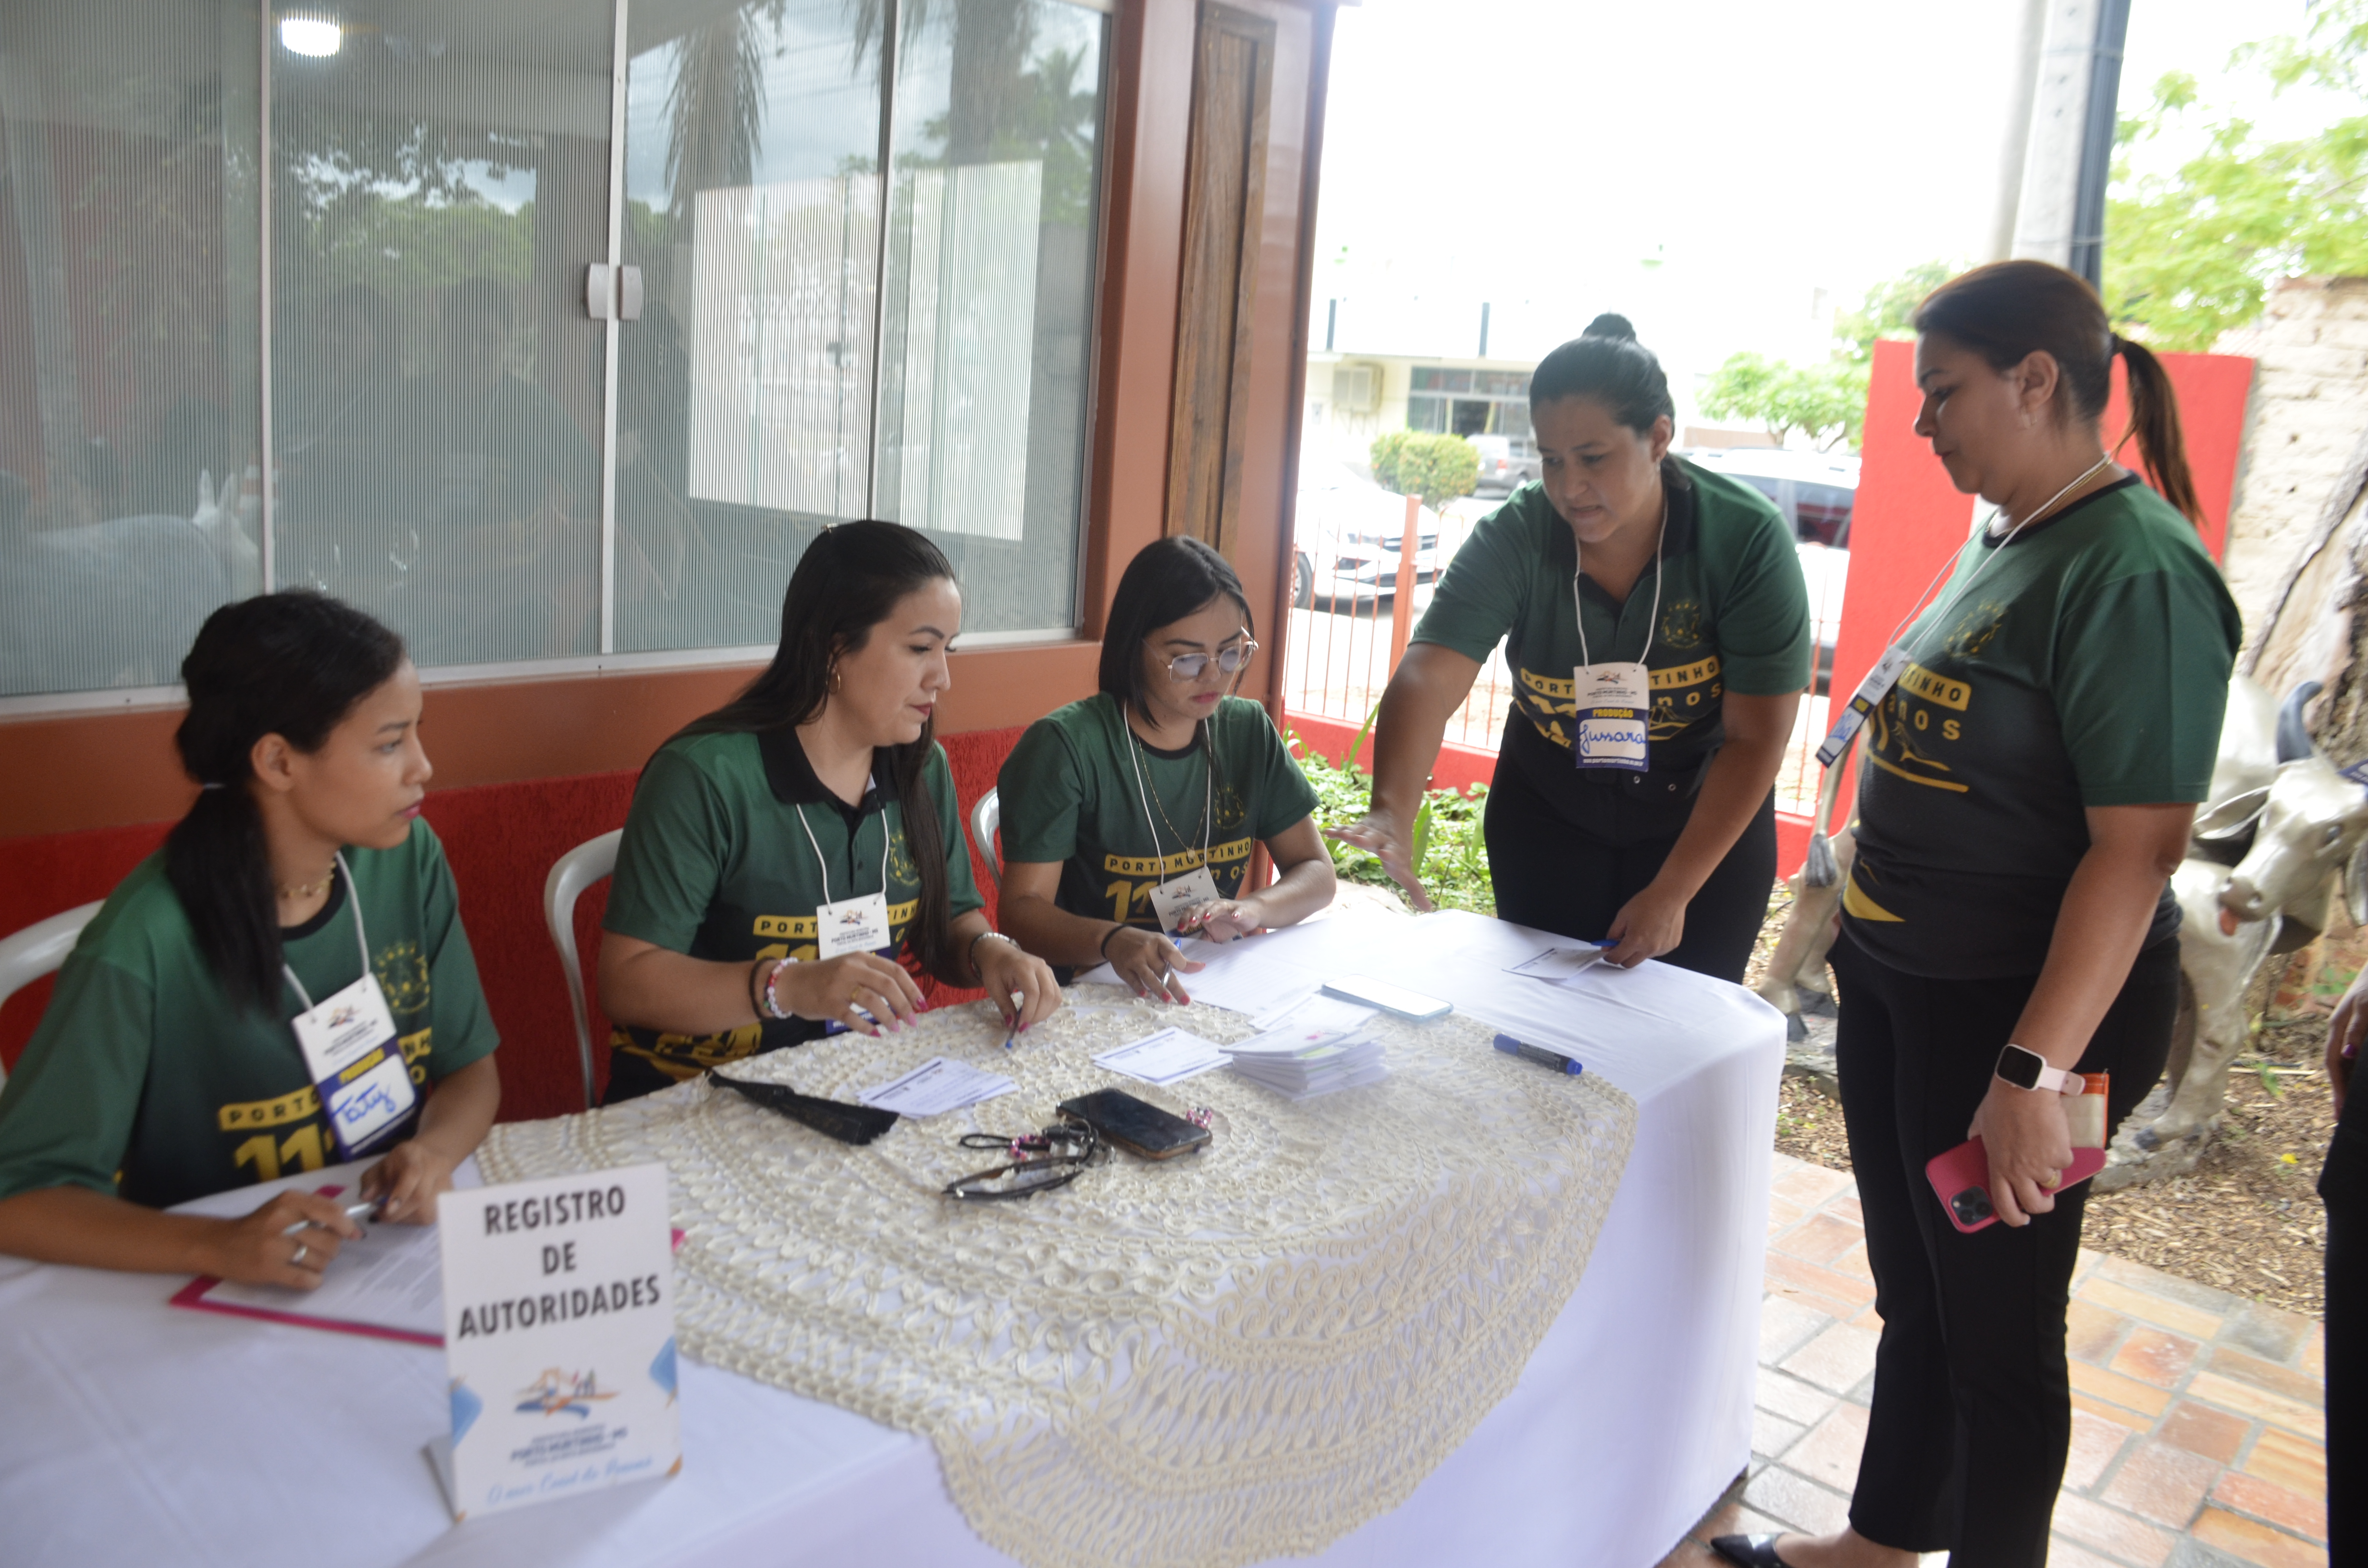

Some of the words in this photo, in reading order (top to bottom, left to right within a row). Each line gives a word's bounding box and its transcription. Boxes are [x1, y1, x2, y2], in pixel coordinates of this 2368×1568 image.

[1525, 674, 1572, 694] PORT
[1652, 662, 1714, 685] TINHO
[1657, 683, 1721, 707] nos
[1592, 708, 1633, 718] PRODUÇÃO
[761, 921, 817, 933] PORT
[234, 1122, 334, 1183] 11
[484, 1185, 626, 1236] REGISTRO
[542, 1241, 577, 1275] DE
[458, 1274, 662, 1339] AUTORIDADES
